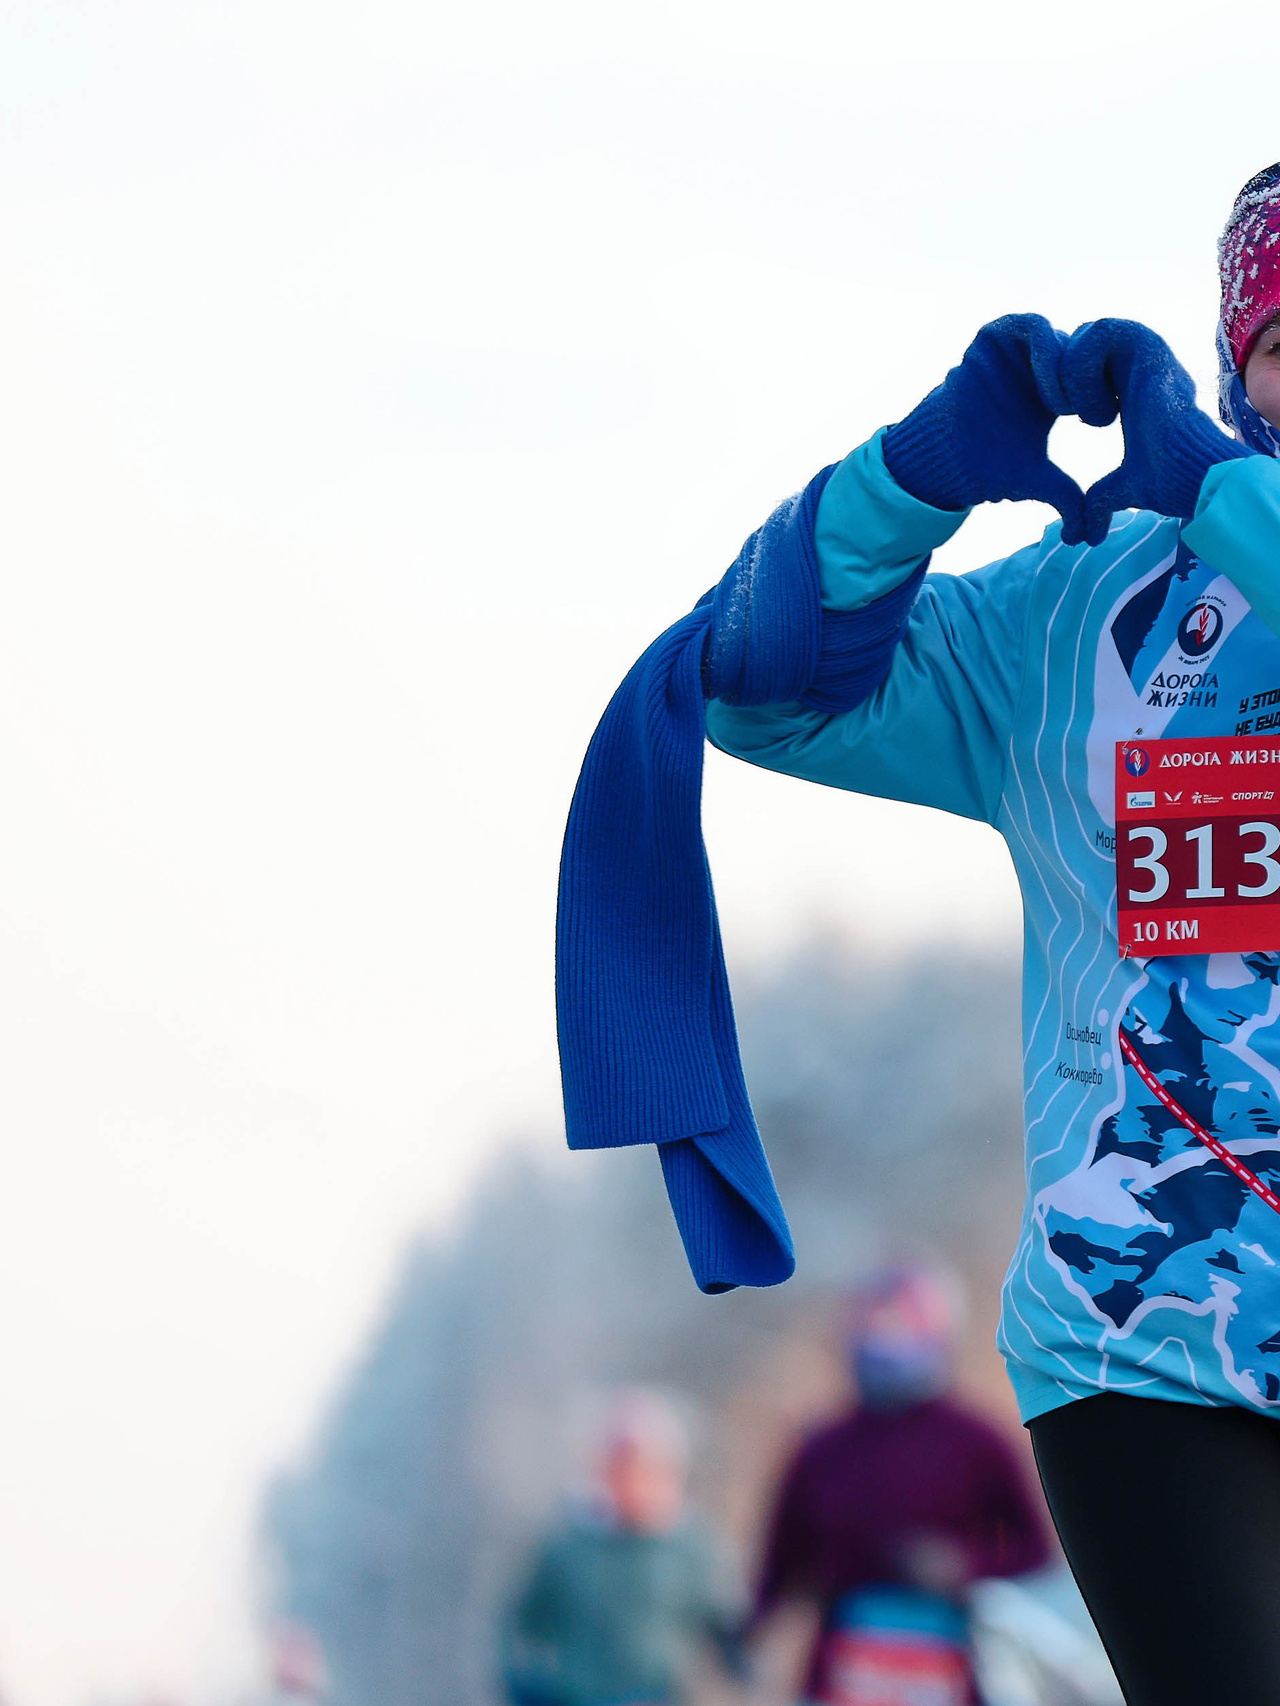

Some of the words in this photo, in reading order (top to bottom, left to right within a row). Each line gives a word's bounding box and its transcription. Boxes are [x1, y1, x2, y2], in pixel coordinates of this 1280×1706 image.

[1151, 671, 1219, 689] ДОРОГА
[1146, 689, 1218, 708] ЖИЗНИ
[1238, 698, 1250, 714] У
[1235, 718, 1254, 736] НЕ
[1159, 751, 1222, 768] ДОРОГА
[1133, 921, 1159, 943] 10
[1166, 919, 1200, 941] КМ
[1055, 1061, 1103, 1087] Коккорево
